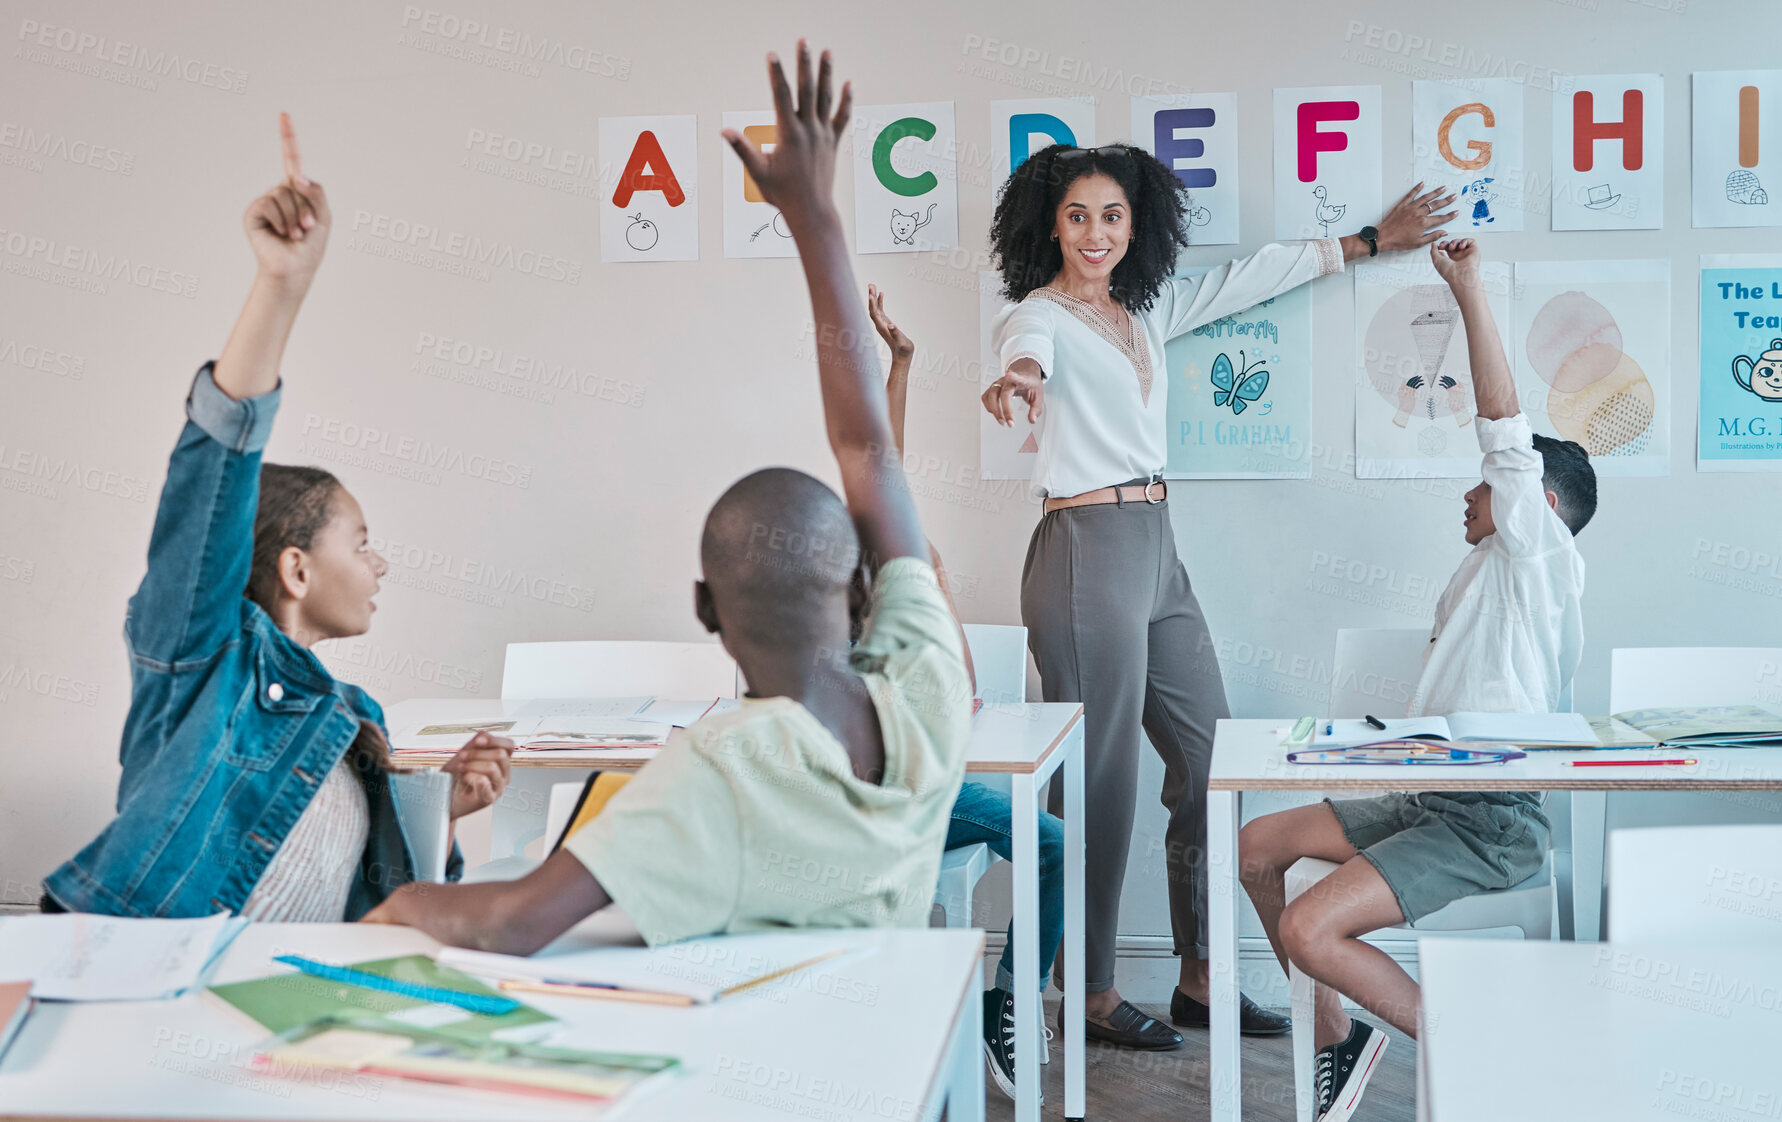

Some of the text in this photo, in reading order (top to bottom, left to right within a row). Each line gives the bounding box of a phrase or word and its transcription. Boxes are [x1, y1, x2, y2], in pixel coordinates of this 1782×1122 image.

[872, 117, 938, 197] C
[1154, 108, 1217, 188] E
[1297, 101, 1360, 183] F
[1437, 102, 1496, 170] G
[1573, 89, 1643, 172] H
[1738, 86, 1760, 168] I
[612, 130, 685, 208] A
[1717, 282, 1763, 300] The
[1733, 312, 1782, 333] Tea
[1718, 417, 1772, 436] M.G.
[1720, 442, 1764, 450] Illustrations
[1766, 442, 1774, 451] by
